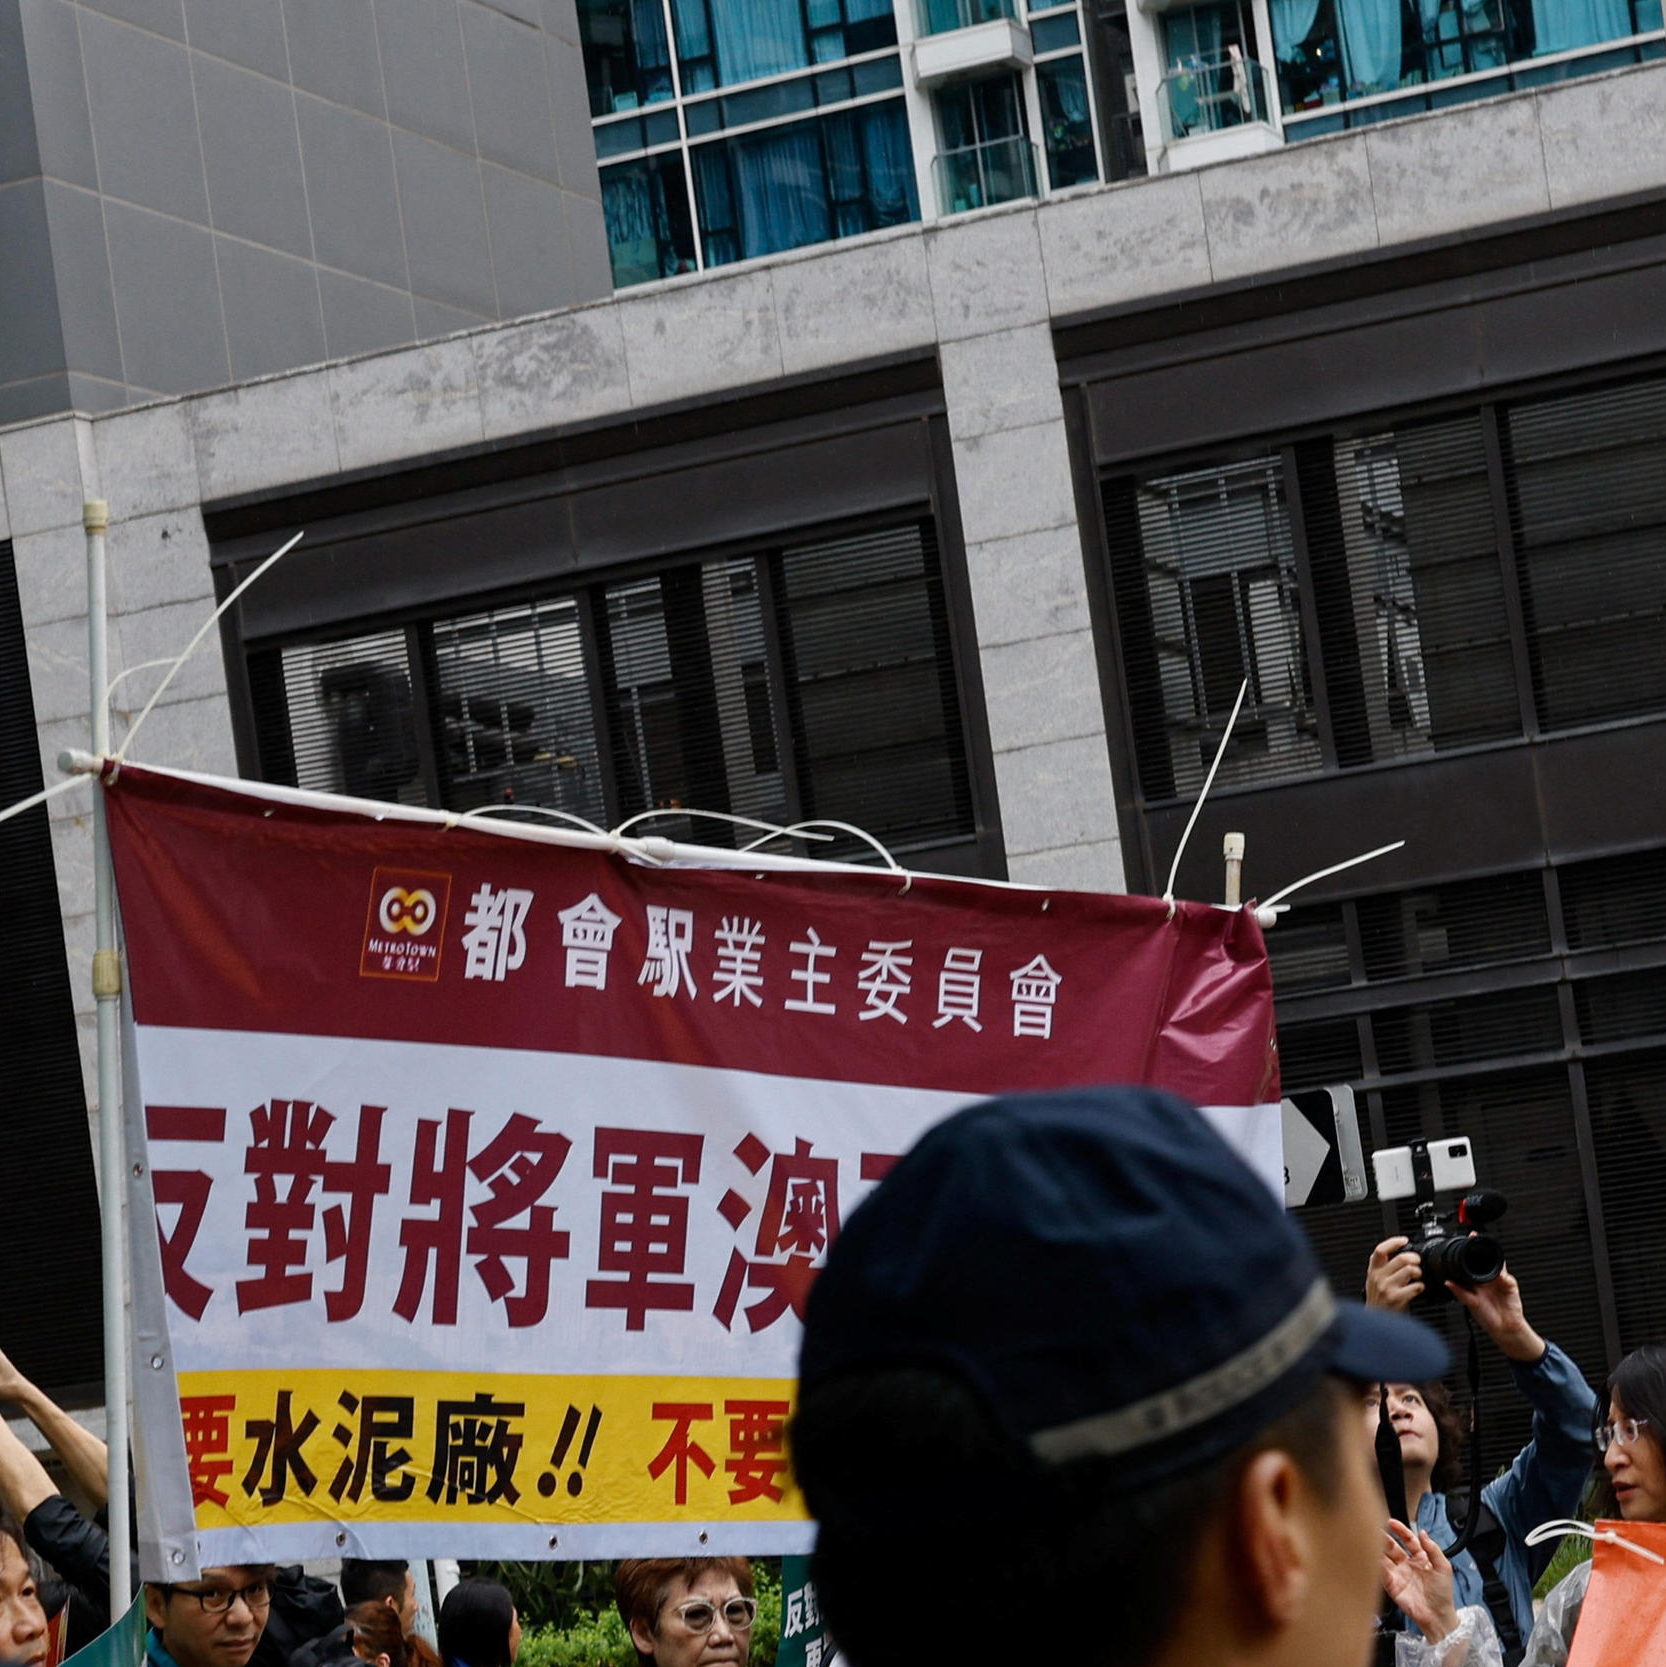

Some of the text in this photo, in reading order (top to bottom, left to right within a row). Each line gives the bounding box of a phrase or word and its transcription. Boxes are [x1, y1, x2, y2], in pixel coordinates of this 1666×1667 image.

[460, 882, 1065, 1041] 都會駅業主委員會
